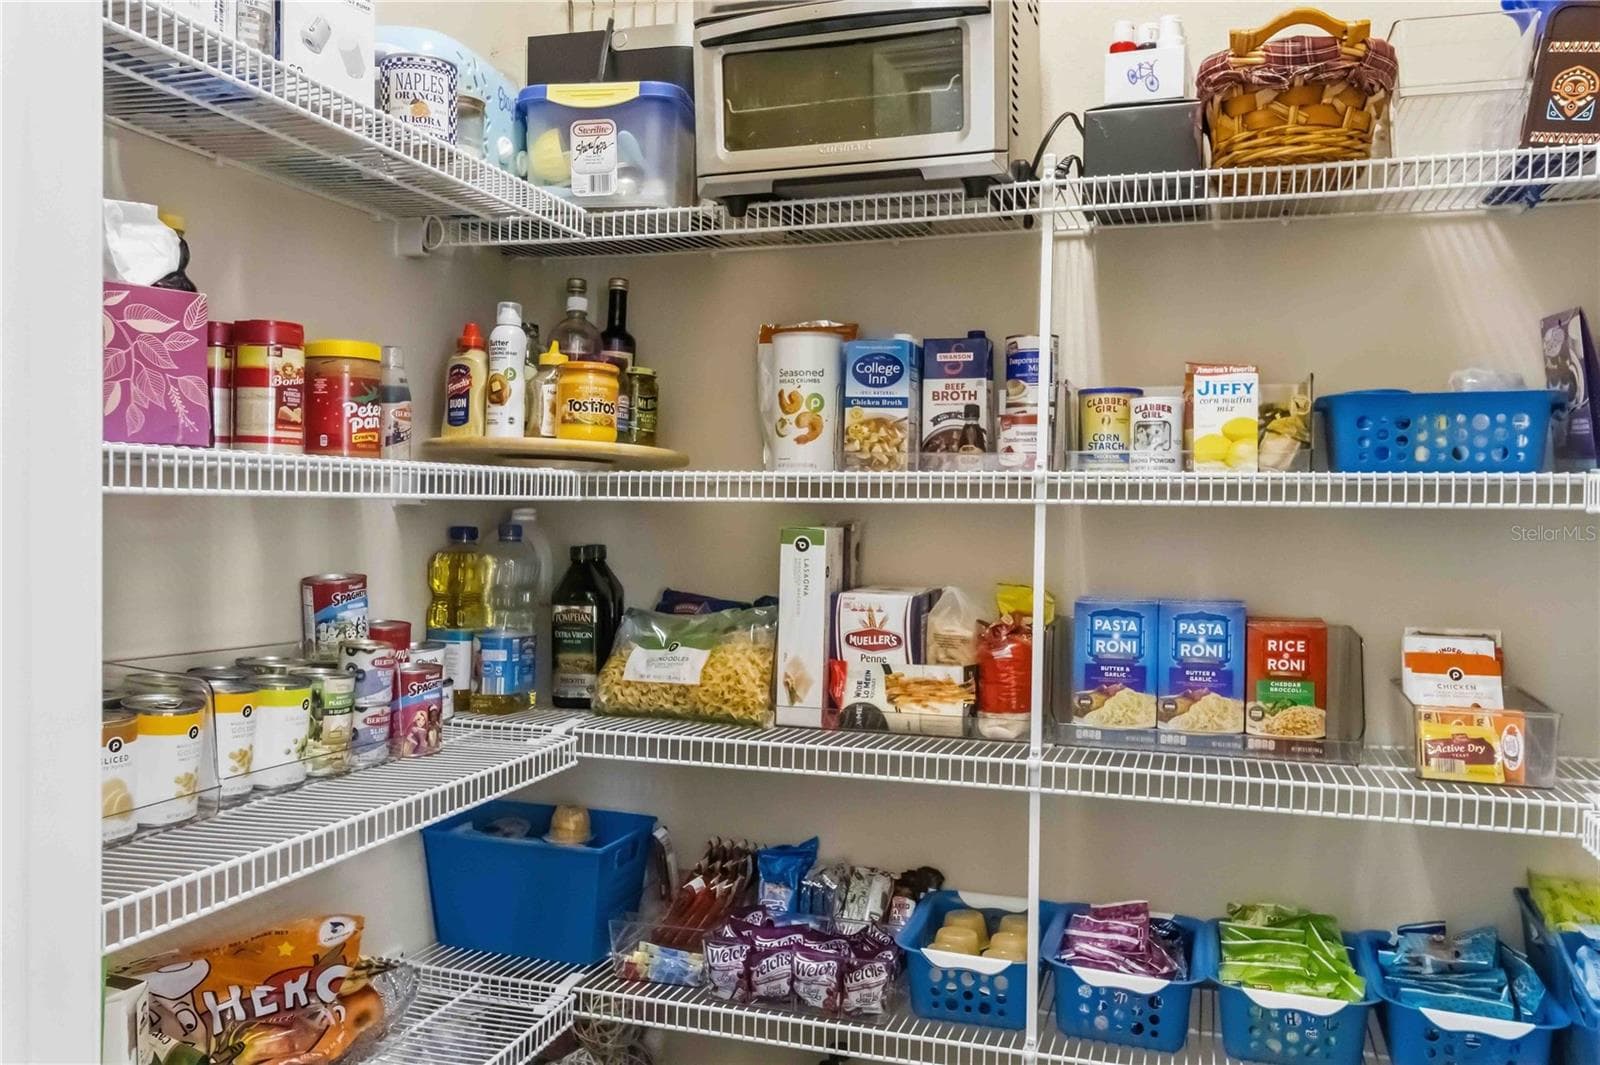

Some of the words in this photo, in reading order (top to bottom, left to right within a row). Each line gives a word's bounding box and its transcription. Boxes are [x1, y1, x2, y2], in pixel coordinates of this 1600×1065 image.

[395, 72, 444, 95] NAPLES
[395, 91, 444, 105] ORANGES
[778, 368, 825, 378] Seasoned
[856, 362, 900, 376] College
[868, 374, 888, 385] Inn
[944, 383, 966, 391] BEEF
[1197, 380, 1255, 396] JIFFY
[932, 390, 978, 401] BROTH
[1199, 397, 1221, 405] corn
[1222, 396, 1252, 405] muffin
[851, 398, 881, 406] Chicken
[1086, 397, 1128, 408] CLABBER
[1095, 405, 1118, 413] GIRL
[1134, 403, 1172, 414] CLABBER
[1216, 404, 1235, 413] mix
[1141, 411, 1163, 419] GIRL
[348, 417, 380, 433] Pan
[1092, 433, 1120, 442] CORN
[1087, 442, 1125, 451] STARCH
[554, 611, 592, 624] POMPEIAN
[1094, 619, 1138, 632] PASTA
[1179, 622, 1224, 636] PASTA
[572, 630, 593, 639] VIRGIN
[849, 633, 898, 647] MUELLER'S
[1095, 639, 1137, 654] RONI
[1180, 643, 1223, 658] RONI
[1267, 640, 1306, 652] RICE
[860, 653, 887, 664] Penne
[1267, 658, 1306, 671] RONI
[864, 669, 872, 689] MEIN
[1436, 683, 1477, 691] CHICKEN
[1435, 744, 1465, 754] Active
[1467, 744, 1486, 754] Dry
[101, 754, 130, 765] LICED
[756, 953, 791, 978] elch's
[796, 959, 837, 977] Welch's
